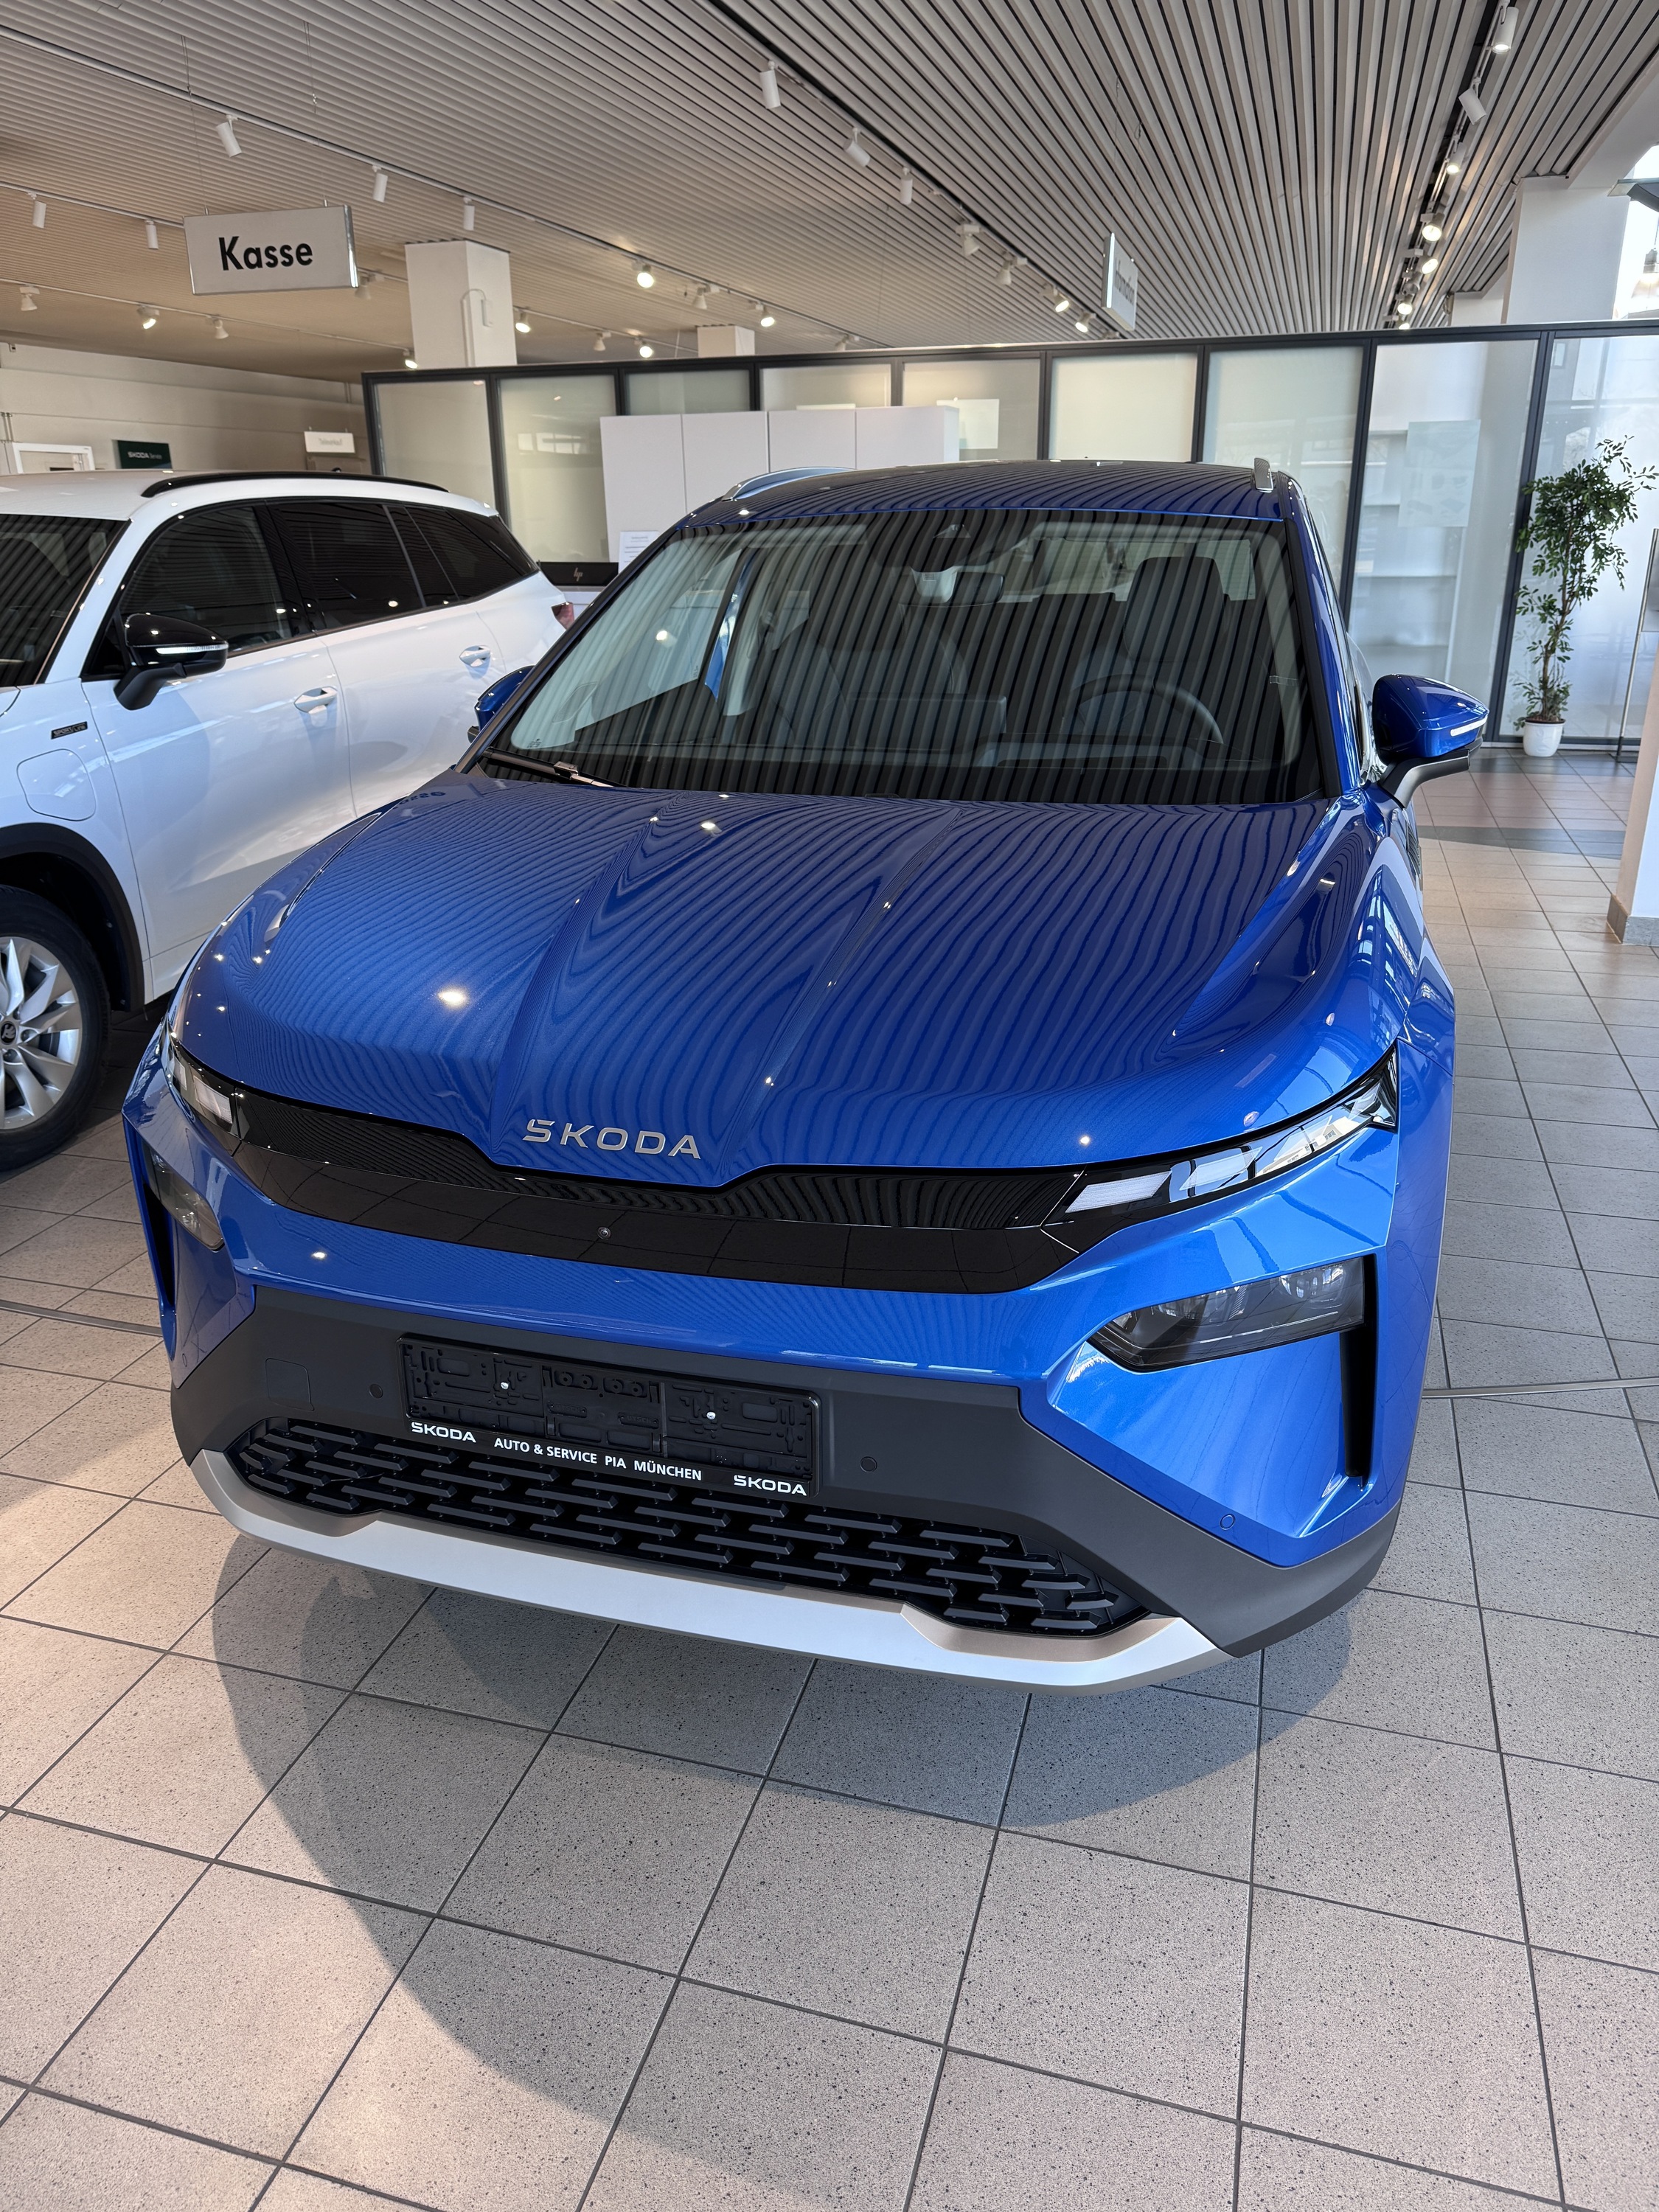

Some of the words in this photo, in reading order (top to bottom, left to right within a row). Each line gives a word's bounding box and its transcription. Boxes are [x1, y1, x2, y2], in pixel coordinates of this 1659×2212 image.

[218, 236, 313, 271] Kasse
[494, 1437, 530, 1453] AUTO
[533, 1444, 543, 1455] &
[546, 1446, 598, 1464] SERVICE
[605, 1455, 627, 1470] PIA
[633, 1459, 703, 1481] MÜNCHEN
